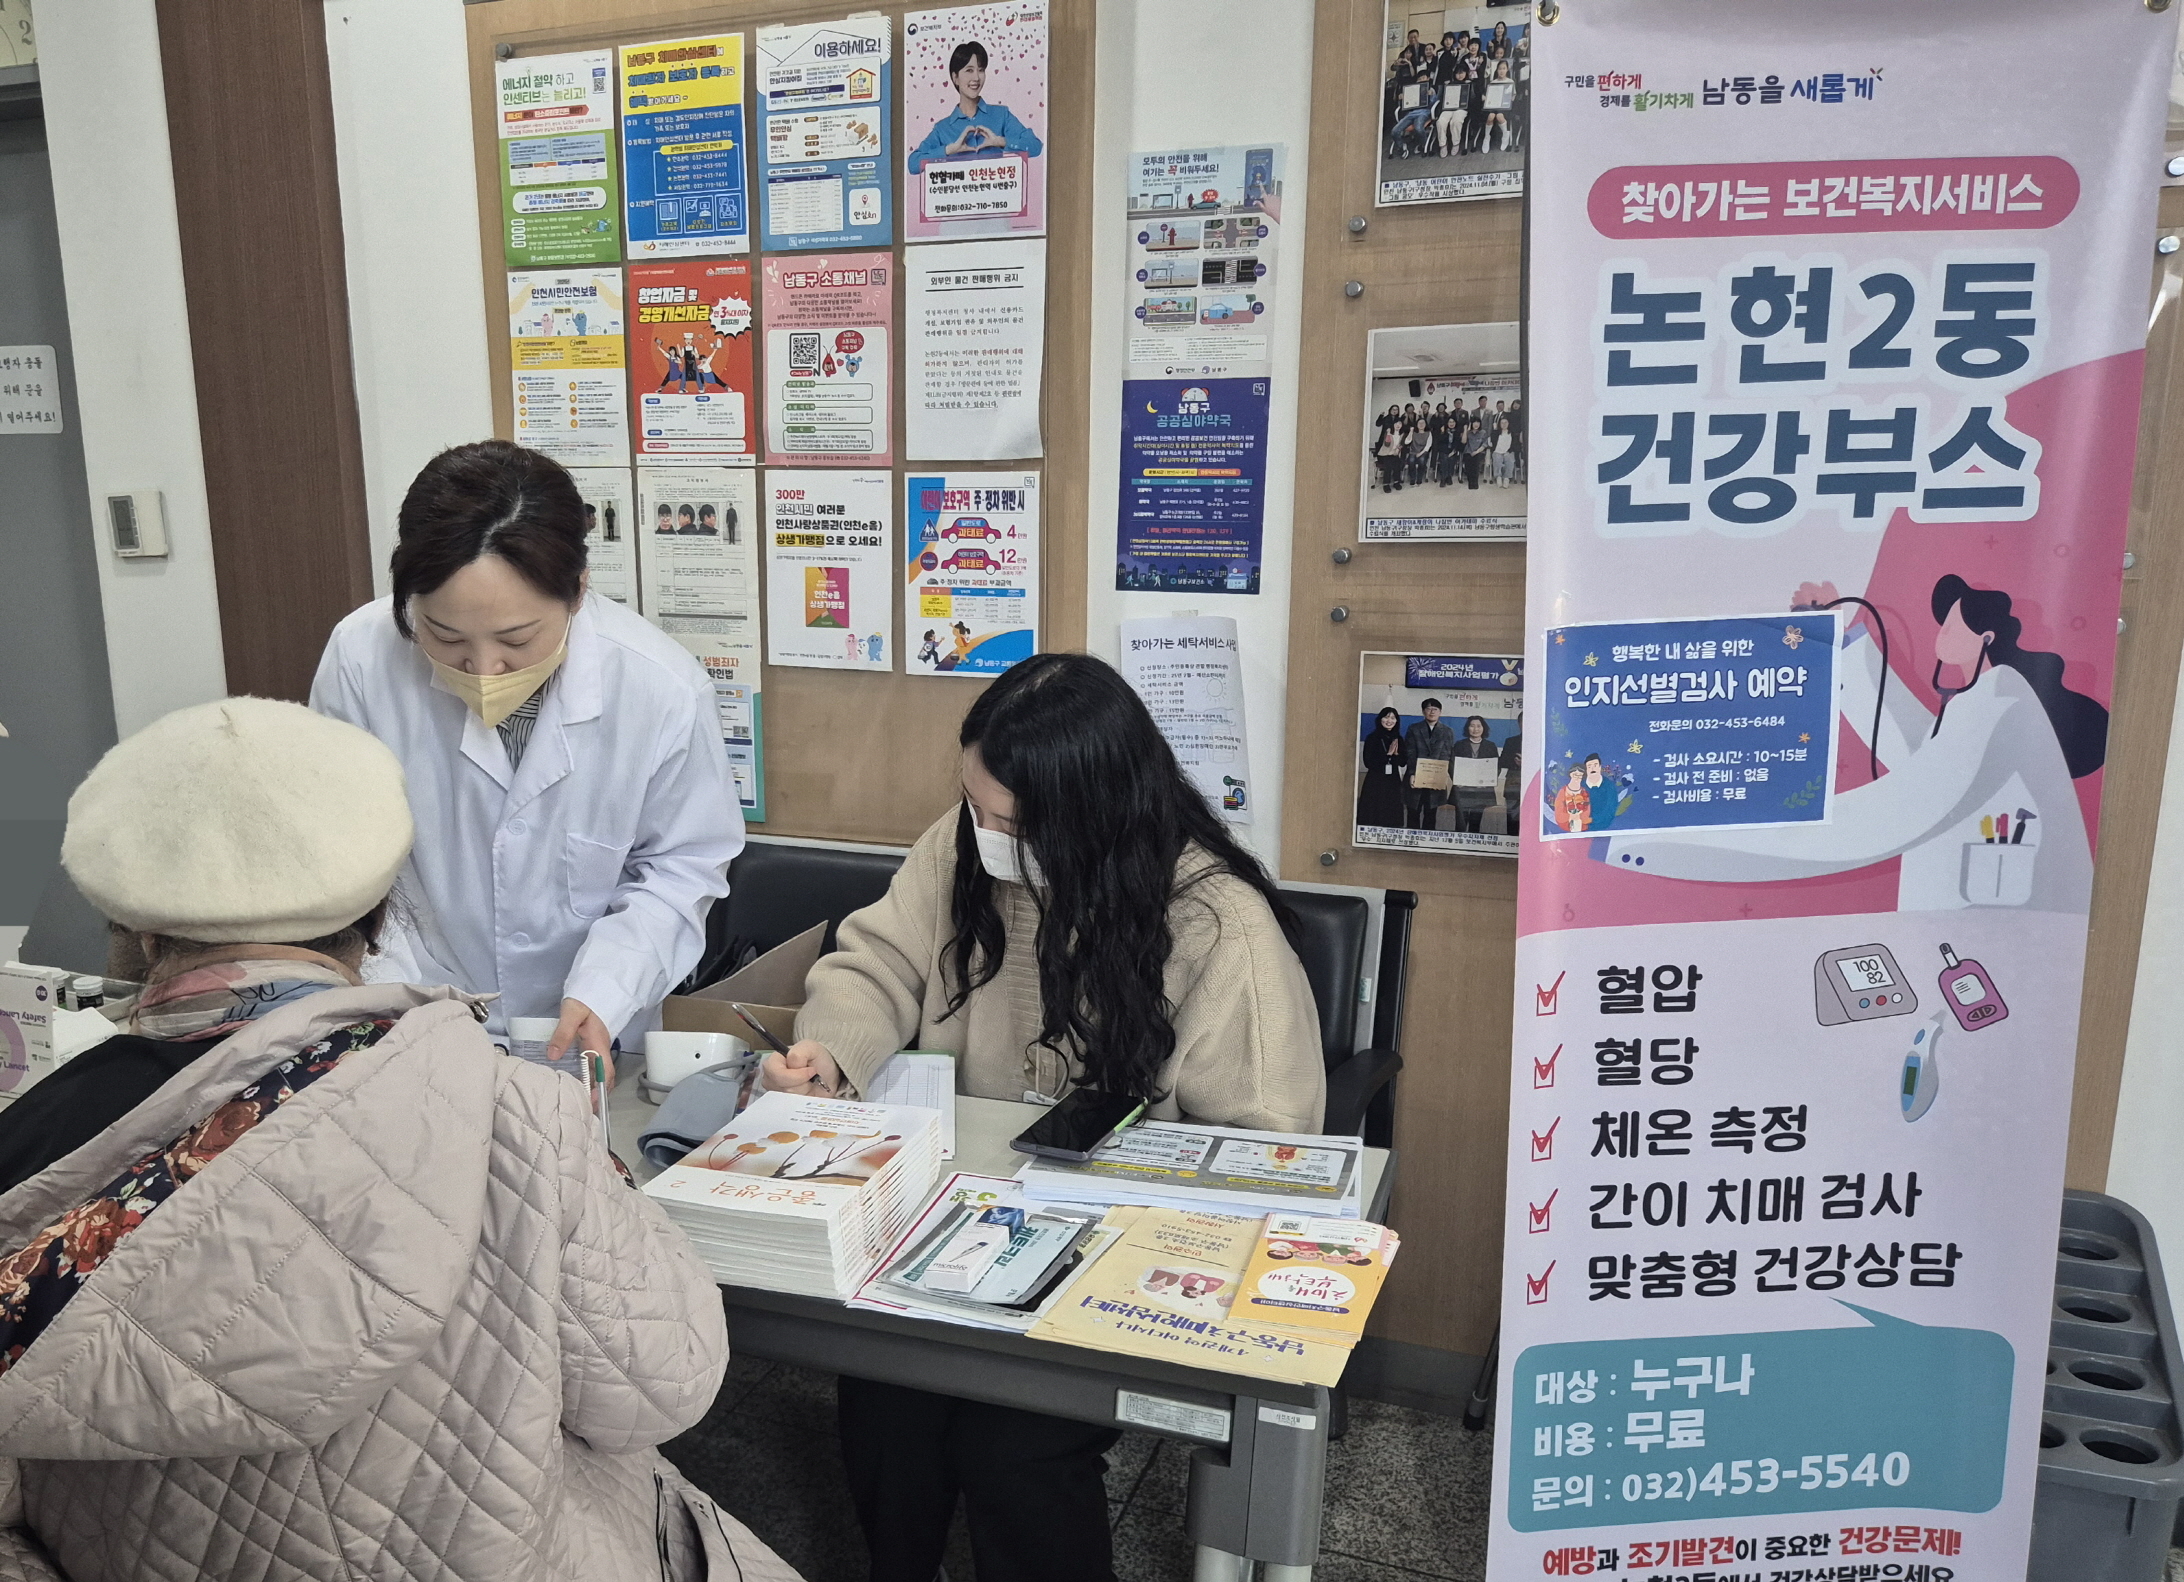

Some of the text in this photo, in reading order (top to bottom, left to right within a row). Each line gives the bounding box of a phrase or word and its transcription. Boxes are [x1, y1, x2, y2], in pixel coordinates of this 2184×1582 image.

[19, 20, 32, 46] 2
[627, 45, 724, 67] 남동구 치매안심센터에
[814, 38, 882, 58] 이용하세요!
[502, 72, 575, 91] 에너지 절약 하고
[668, 67, 698, 82] 보호자
[700, 65, 735, 79] 등록하고
[1564, 72, 1642, 91] 구민을 편하게
[503, 87, 586, 106] 인센티브는 늘리고!
[1702, 73, 1876, 106] 남동을 새롭게
[1599, 91, 1694, 112] 경제를 활기차게
[1142, 153, 1208, 166] 모두의 안전을 위해
[929, 170, 965, 184] 헌혈카페
[1142, 164, 1220, 177] 여기는 꼭 비워두세요!
[1621, 173, 2045, 223] 찾아가는 보건복지서비스
[783, 269, 868, 289] 남동구 소통채널
[930, 273, 1019, 285] 외부인 물건 판매행위 금지
[531, 286, 598, 299] 인천시민안전보험
[638, 286, 698, 305] 창업자금 및
[638, 305, 711, 324] 경영개선자금
[1602, 262, 2037, 387] 논현2동
[1178, 402, 1211, 415] 남동구
[1156, 414, 1232, 428] 공공심야약국
[1597, 406, 2027, 524] 건강부스
[775, 489, 805, 500] 300만
[1001, 490, 1017, 511] 위반
[1017, 490, 1025, 512] 시
[775, 503, 846, 516] 인천시민 여러분
[775, 518, 883, 532] 인천사랑상품권(인천e음)
[958, 527, 985, 538] 과태료
[775, 534, 882, 547] 상생가맹점으로 오세요!
[958, 559, 985, 569] 과태료
[1130, 637, 1175, 652] 찾아가는
[1176, 636, 1225, 650] 세탁서비스
[1612, 639, 1754, 663] 행복한 내 삶을 위한
[703, 656, 740, 668] 성범죄자
[1440, 663, 1474, 672] 2024년
[1564, 664, 1808, 709] 인지선별검사 예약
[1648, 715, 1786, 733] 전화문의 032-453-6484
[1663, 747, 1808, 768] 검사 소요시간 10~15분
[1663, 768, 1769, 786] 검사 전 준비 없음
[1663, 788, 1747, 805] 검사비용 무료
[1852, 958, 1879, 972] 100
[1866, 971, 1887, 985] 82
[1597, 964, 1703, 1015] 혈압
[21, 1013, 47, 1024] Safety
[4, 1061, 30, 1072] Lancet
[1594, 1037, 1700, 1087] 혈당
[1590, 1104, 1808, 1158] 체온 측정
[669, 1180, 817, 1206] 좋은생각 2
[1588, 1171, 1922, 1230] 간이 치매 검사
[932, 1261, 968, 1272] microlife
[1587, 1242, 1963, 1302] 맞춤형 건강상담
[1079, 1295, 1305, 1357] 남동구 치매안심센터
[1115, 1320, 1250, 1357] 4개권역 어디서나
[1535, 1353, 1755, 1406] 대상 누구나
[1534, 1408, 1706, 1458] 비용 무료
[1531, 1450, 1911, 1512] 문의 032)453-5540
[1542, 1525, 1962, 1577] 예방과 조기발견이 중요한 건강문제!
